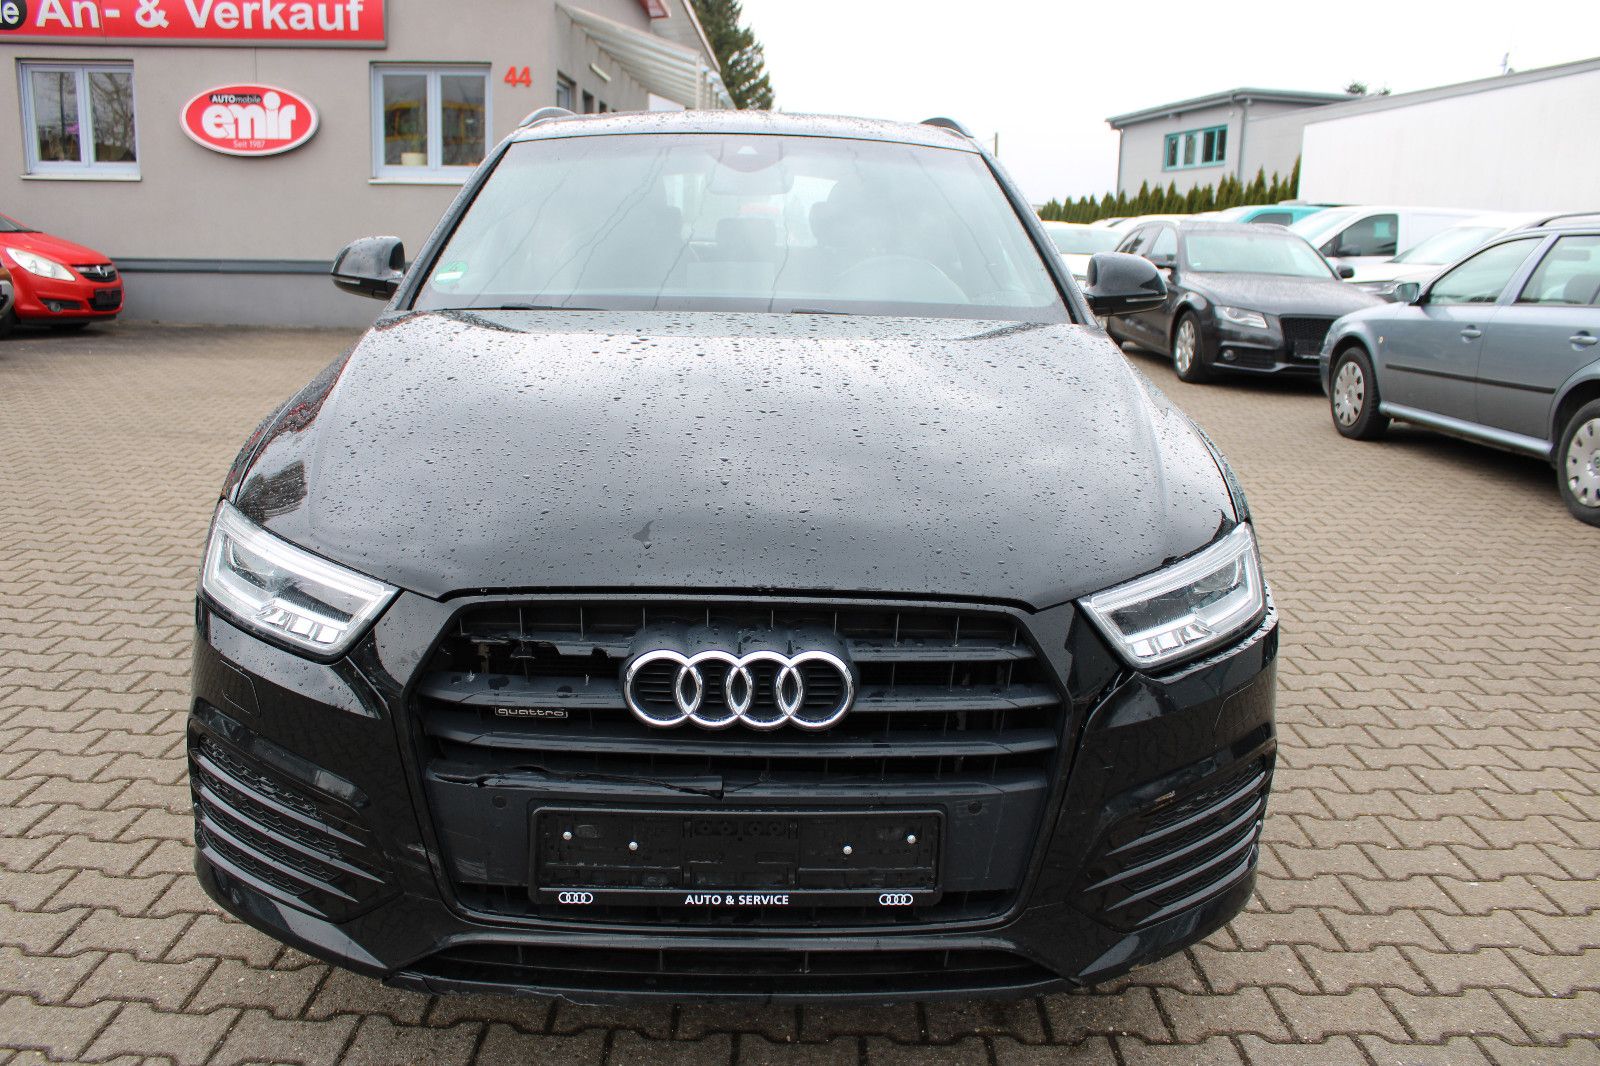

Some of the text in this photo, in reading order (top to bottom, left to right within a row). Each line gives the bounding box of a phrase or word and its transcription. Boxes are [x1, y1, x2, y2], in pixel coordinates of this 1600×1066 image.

[36, 0, 120, 28] An-
[135, 0, 169, 28] &
[184, 0, 364, 31] Verkauf
[504, 66, 532, 87] 44
[211, 94, 261, 103] AUTOmobile
[202, 91, 296, 139] emir
[497, 708, 565, 717] quattro
[685, 895, 789, 905] AUTO & SERVICE
